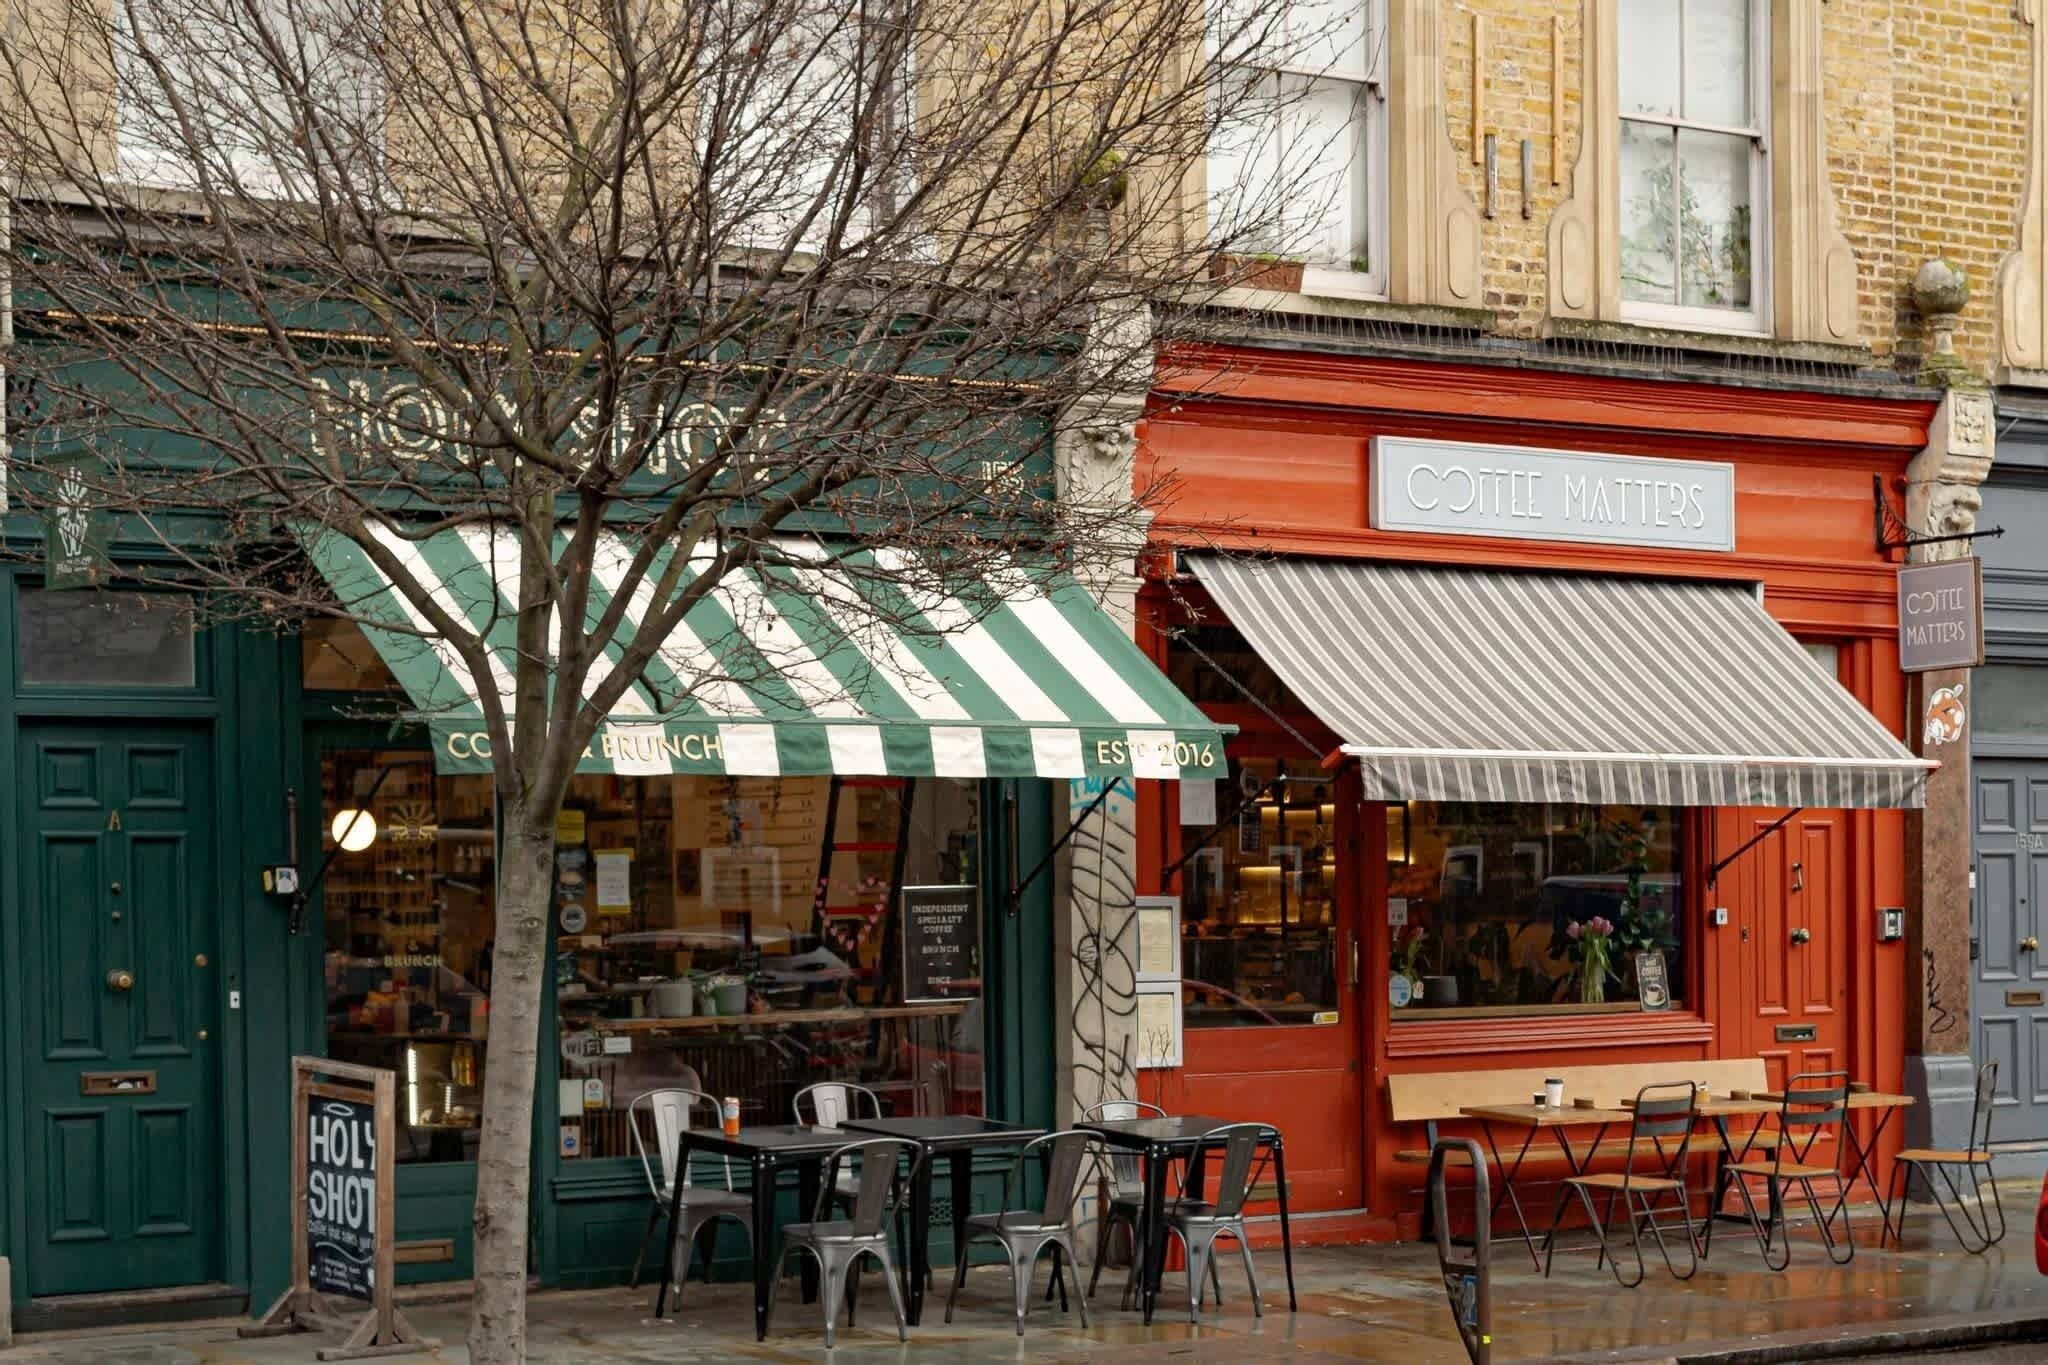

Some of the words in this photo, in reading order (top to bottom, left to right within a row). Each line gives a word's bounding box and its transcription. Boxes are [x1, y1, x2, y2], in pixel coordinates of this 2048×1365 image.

[1407, 462, 1544, 513] COFFEE
[1563, 472, 1706, 529] MATTERS
[1906, 587, 1966, 615] COFFEE
[1906, 620, 1966, 648] MATTERS
[601, 732, 724, 763] BRUNCH
[1157, 741, 1215, 768] 2016
[923, 925, 953, 934] COFFEE
[383, 954, 443, 968] BRUNCH
[922, 946, 959, 954] BRUNCH
[310, 1115, 375, 1171] HOLY
[310, 1169, 375, 1233] SHOT
